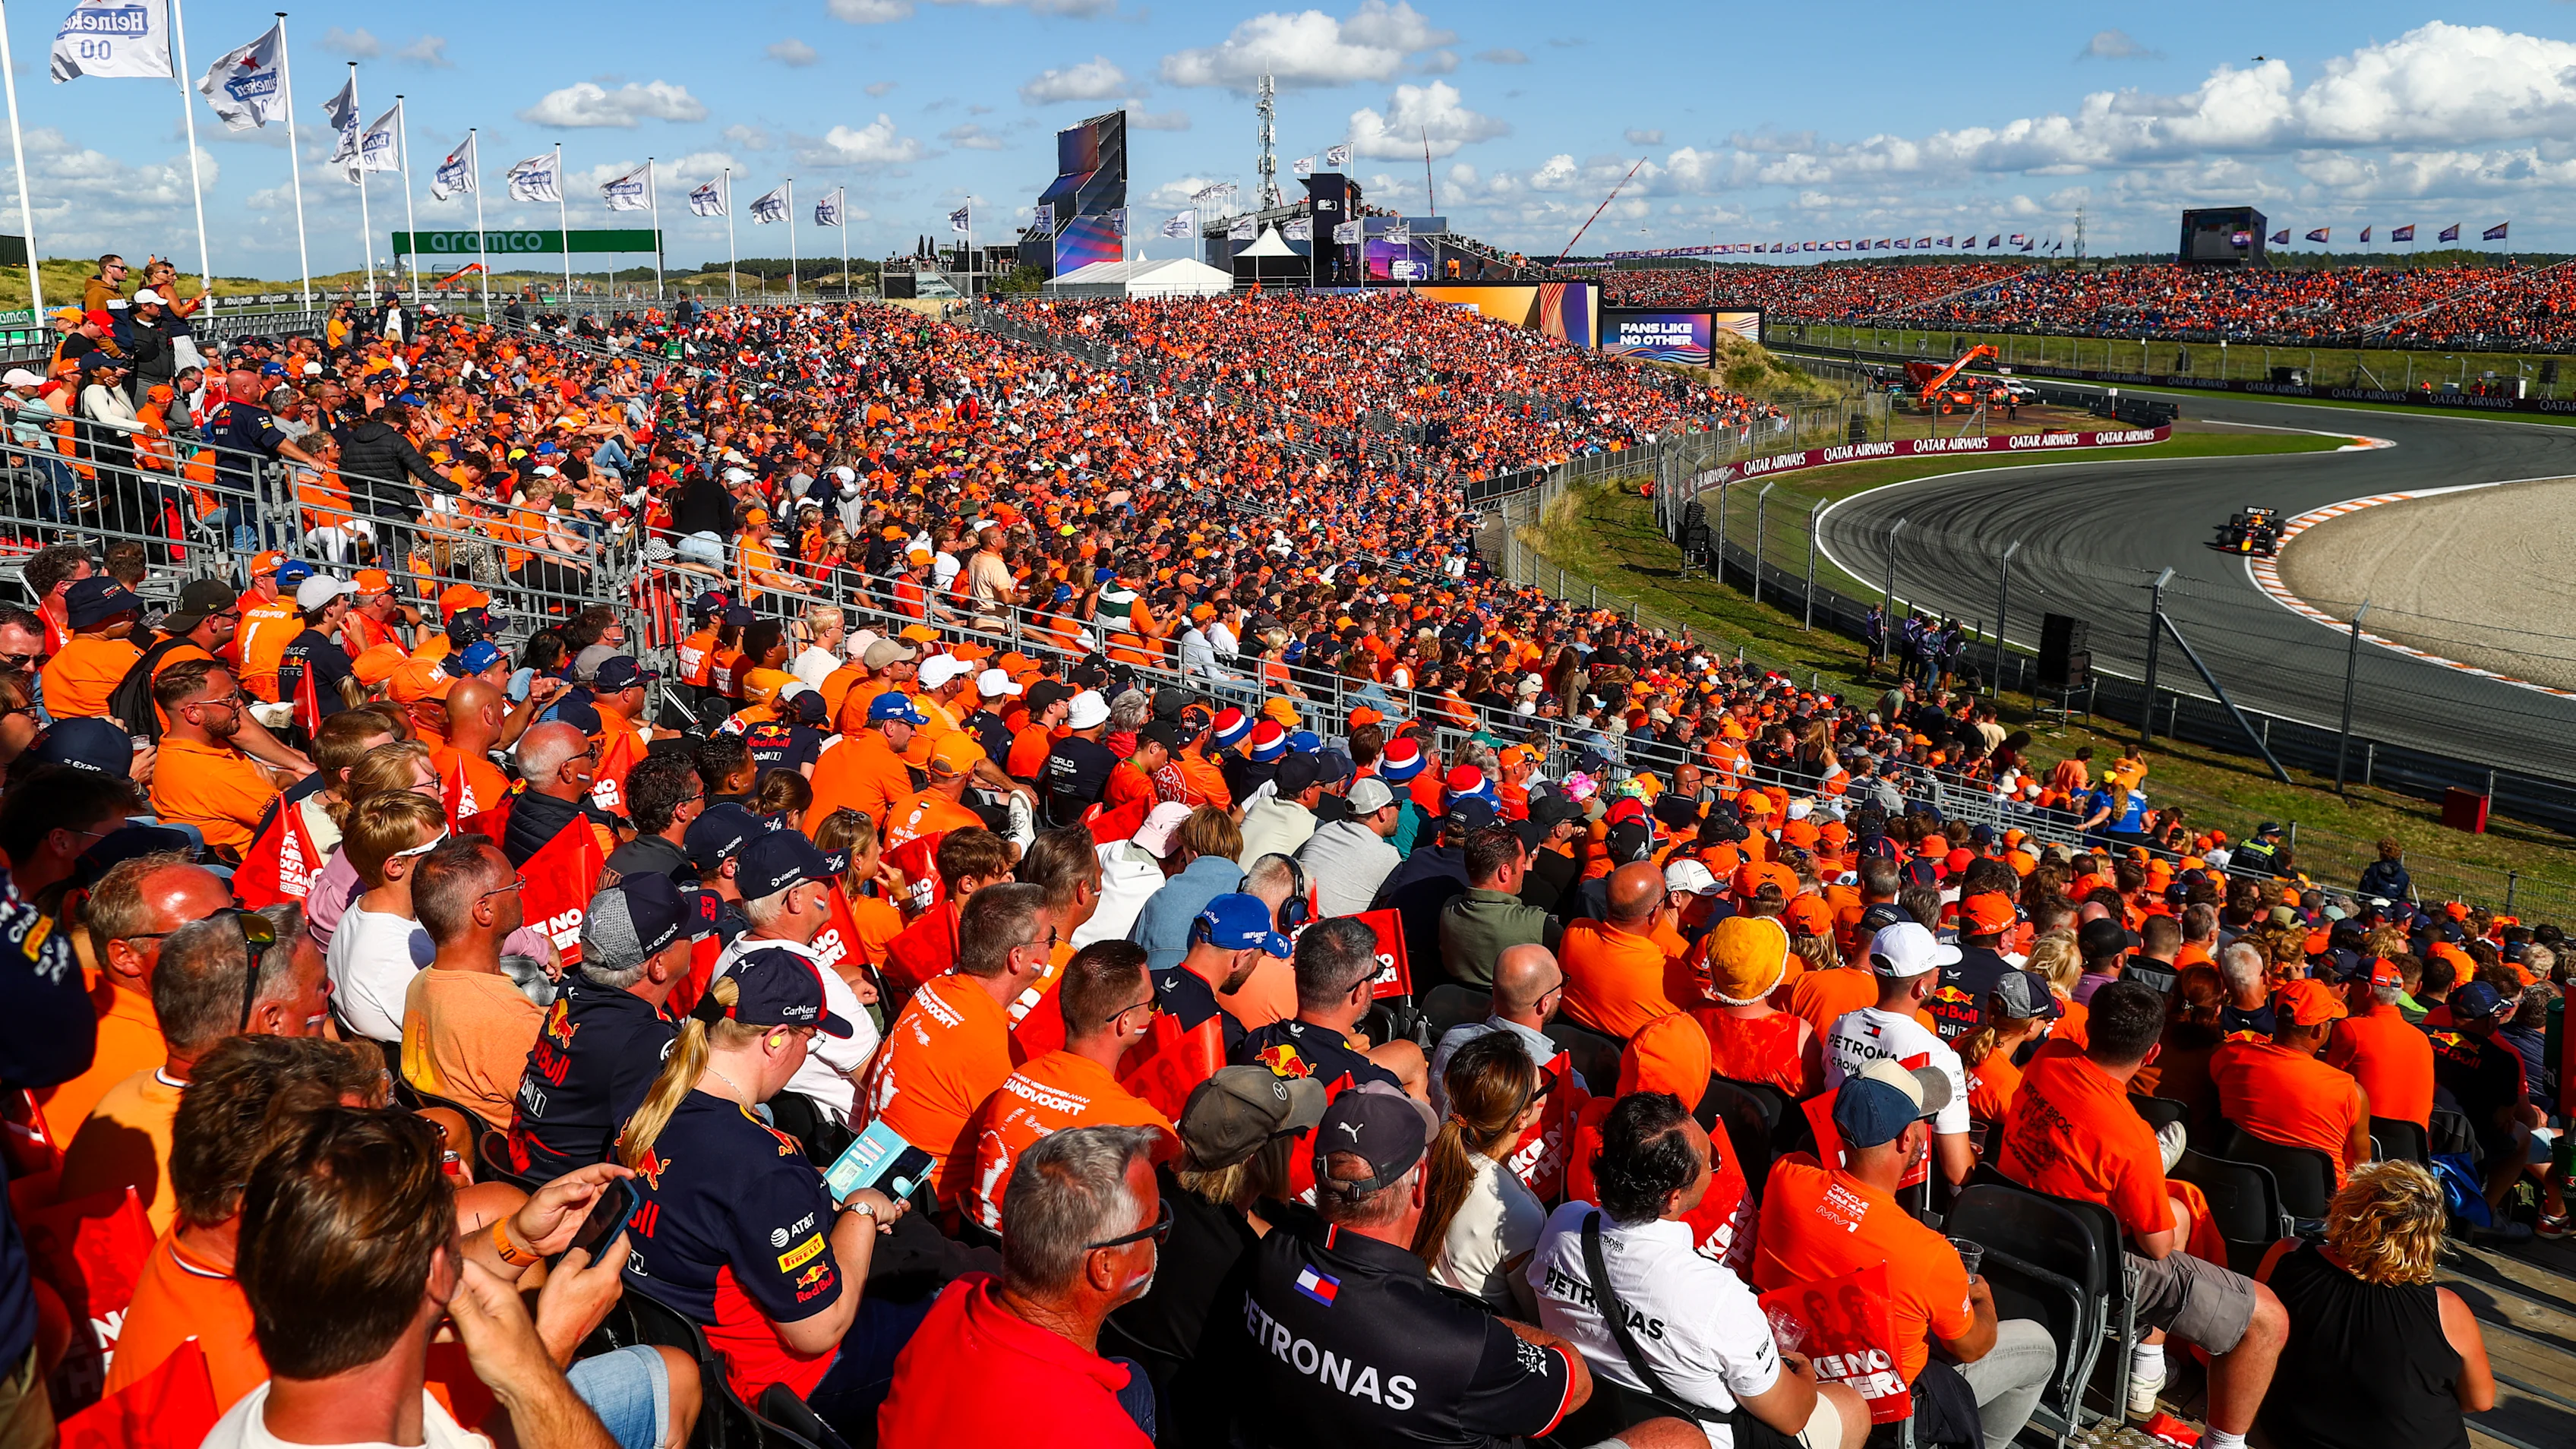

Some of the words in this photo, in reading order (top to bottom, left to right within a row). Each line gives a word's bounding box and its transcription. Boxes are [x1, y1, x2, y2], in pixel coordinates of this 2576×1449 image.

[431, 233, 542, 251] aramco
[1620, 323, 1660, 334] FANS
[1661, 323, 1693, 334] LIKE
[1619, 335, 1642, 346] NO
[1643, 335, 1693, 346] OTHER
[2167, 378, 2195, 387] QATAR
[2246, 383, 2275, 393] QATAR
[2275, 385, 2312, 396] AIRWAYS
[2331, 388, 2366, 399] QATAR
[2367, 390, 2407, 402] AIRWAYS
[2429, 393, 2464, 406] QATAR
[2467, 396, 2514, 409] AIRWAYS
[1914, 438, 1946, 453] QATAR
[1947, 437, 1989, 450] AIRWAYS
[2009, 434, 2040, 450] QATAR
[2041, 433, 2079, 447] AIRWAYS
[2096, 431, 2124, 445] QATAR
[2126, 429, 2155, 443] AIRWAYS
[1823, 447, 1855, 462] QATAR
[1855, 441, 1895, 457] AIRWAYS
[1744, 460, 1769, 476] QATAR
[1770, 452, 1806, 472] AIRWAYS
[244, 622, 261, 665] 1
[284, 646, 309, 656] RACLE
[766, 736, 790, 748] Bull
[750, 751, 769, 761] obil
[257, 792, 279, 817] CREW
[779, 866, 800, 882] viaplay
[548, 908, 582, 933] NO
[653, 922, 678, 947] exact
[782, 1005, 818, 1017] CarNext
[1947, 1005, 1979, 1024] Bull
[1828, 1033, 1897, 1059] PETRONA
[1002, 1078, 1086, 1116] ZANDVOORT
[1031, 1080, 1070, 1098] VERSTAPPEN
[1830, 1182, 1870, 1210] ORACLE
[1823, 1196, 1863, 1222] RACING
[628, 1199, 660, 1239] ull
[791, 1211, 814, 1238] AT&T
[1602, 1234, 1624, 1251] BOSS
[783, 1241, 821, 1267] PIRELLI
[795, 1283, 821, 1303] Red
[819, 1271, 835, 1293] Bull
[1545, 1266, 1665, 1341] PETRNAS
[1852, 1349, 1892, 1373] NO
